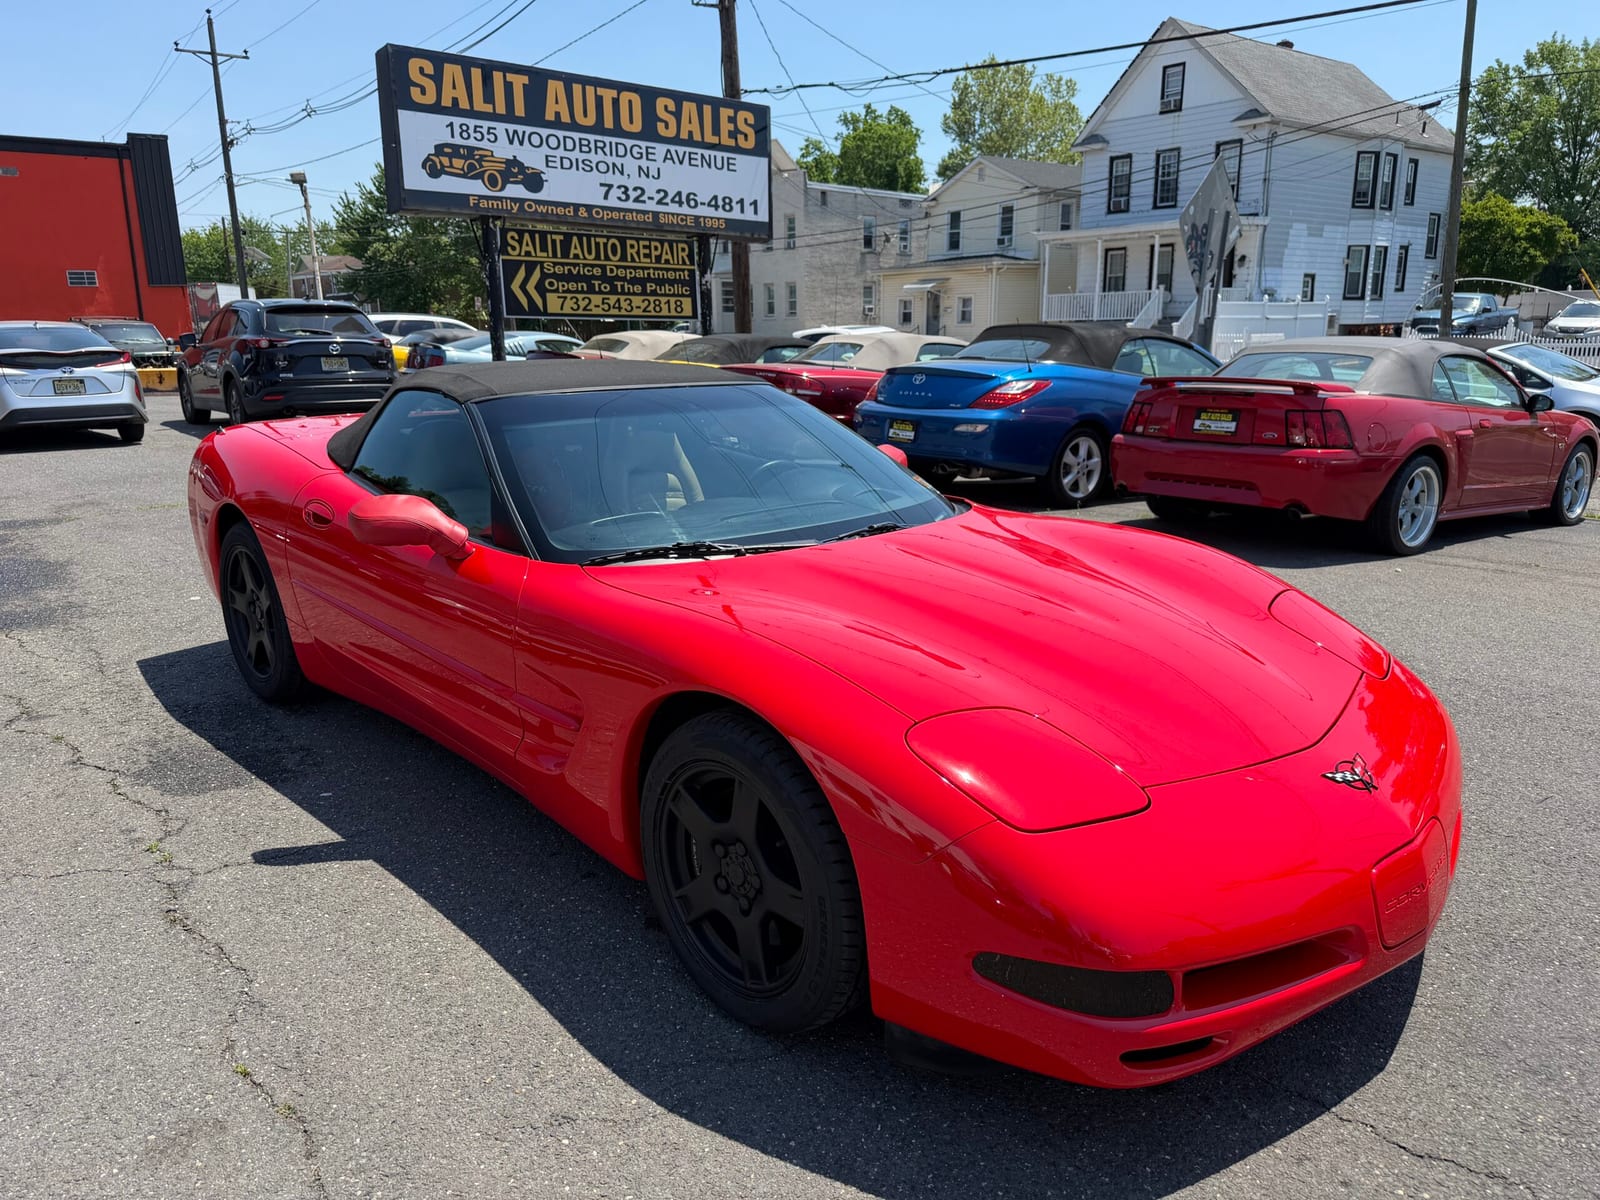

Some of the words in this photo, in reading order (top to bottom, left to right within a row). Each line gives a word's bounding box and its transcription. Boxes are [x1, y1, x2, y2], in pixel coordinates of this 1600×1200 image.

[408, 57, 529, 117] SALIT
[544, 79, 643, 133] AUTO
[655, 96, 756, 149] SALES
[445, 121, 498, 144] 1855
[504, 128, 657, 162] WOODBRIDGE
[662, 148, 737, 172] AVENUE
[545, 154, 631, 180] EDISON,
[638, 165, 661, 180] NJ
[469, 196, 519, 213] Family
[524, 201, 574, 216] Owned
[578, 207, 588, 217] &
[592, 207, 652, 222] Operated
[659, 213, 695, 226] SINCE
[699, 217, 726, 229] 1995
[599, 182, 758, 215] 732-246-4811
[506, 231, 564, 258] SALIT
[569, 235, 621, 262] AUTO
[627, 239, 690, 265] REPAIR
[543, 262, 602, 276] Service
[606, 265, 690, 280] Department
[545, 278, 587, 293] Open
[591, 280, 610, 293] To
[614, 281, 642, 294] The
[646, 283, 691, 295] Public
[556, 295, 684, 314] 732-543-2818
